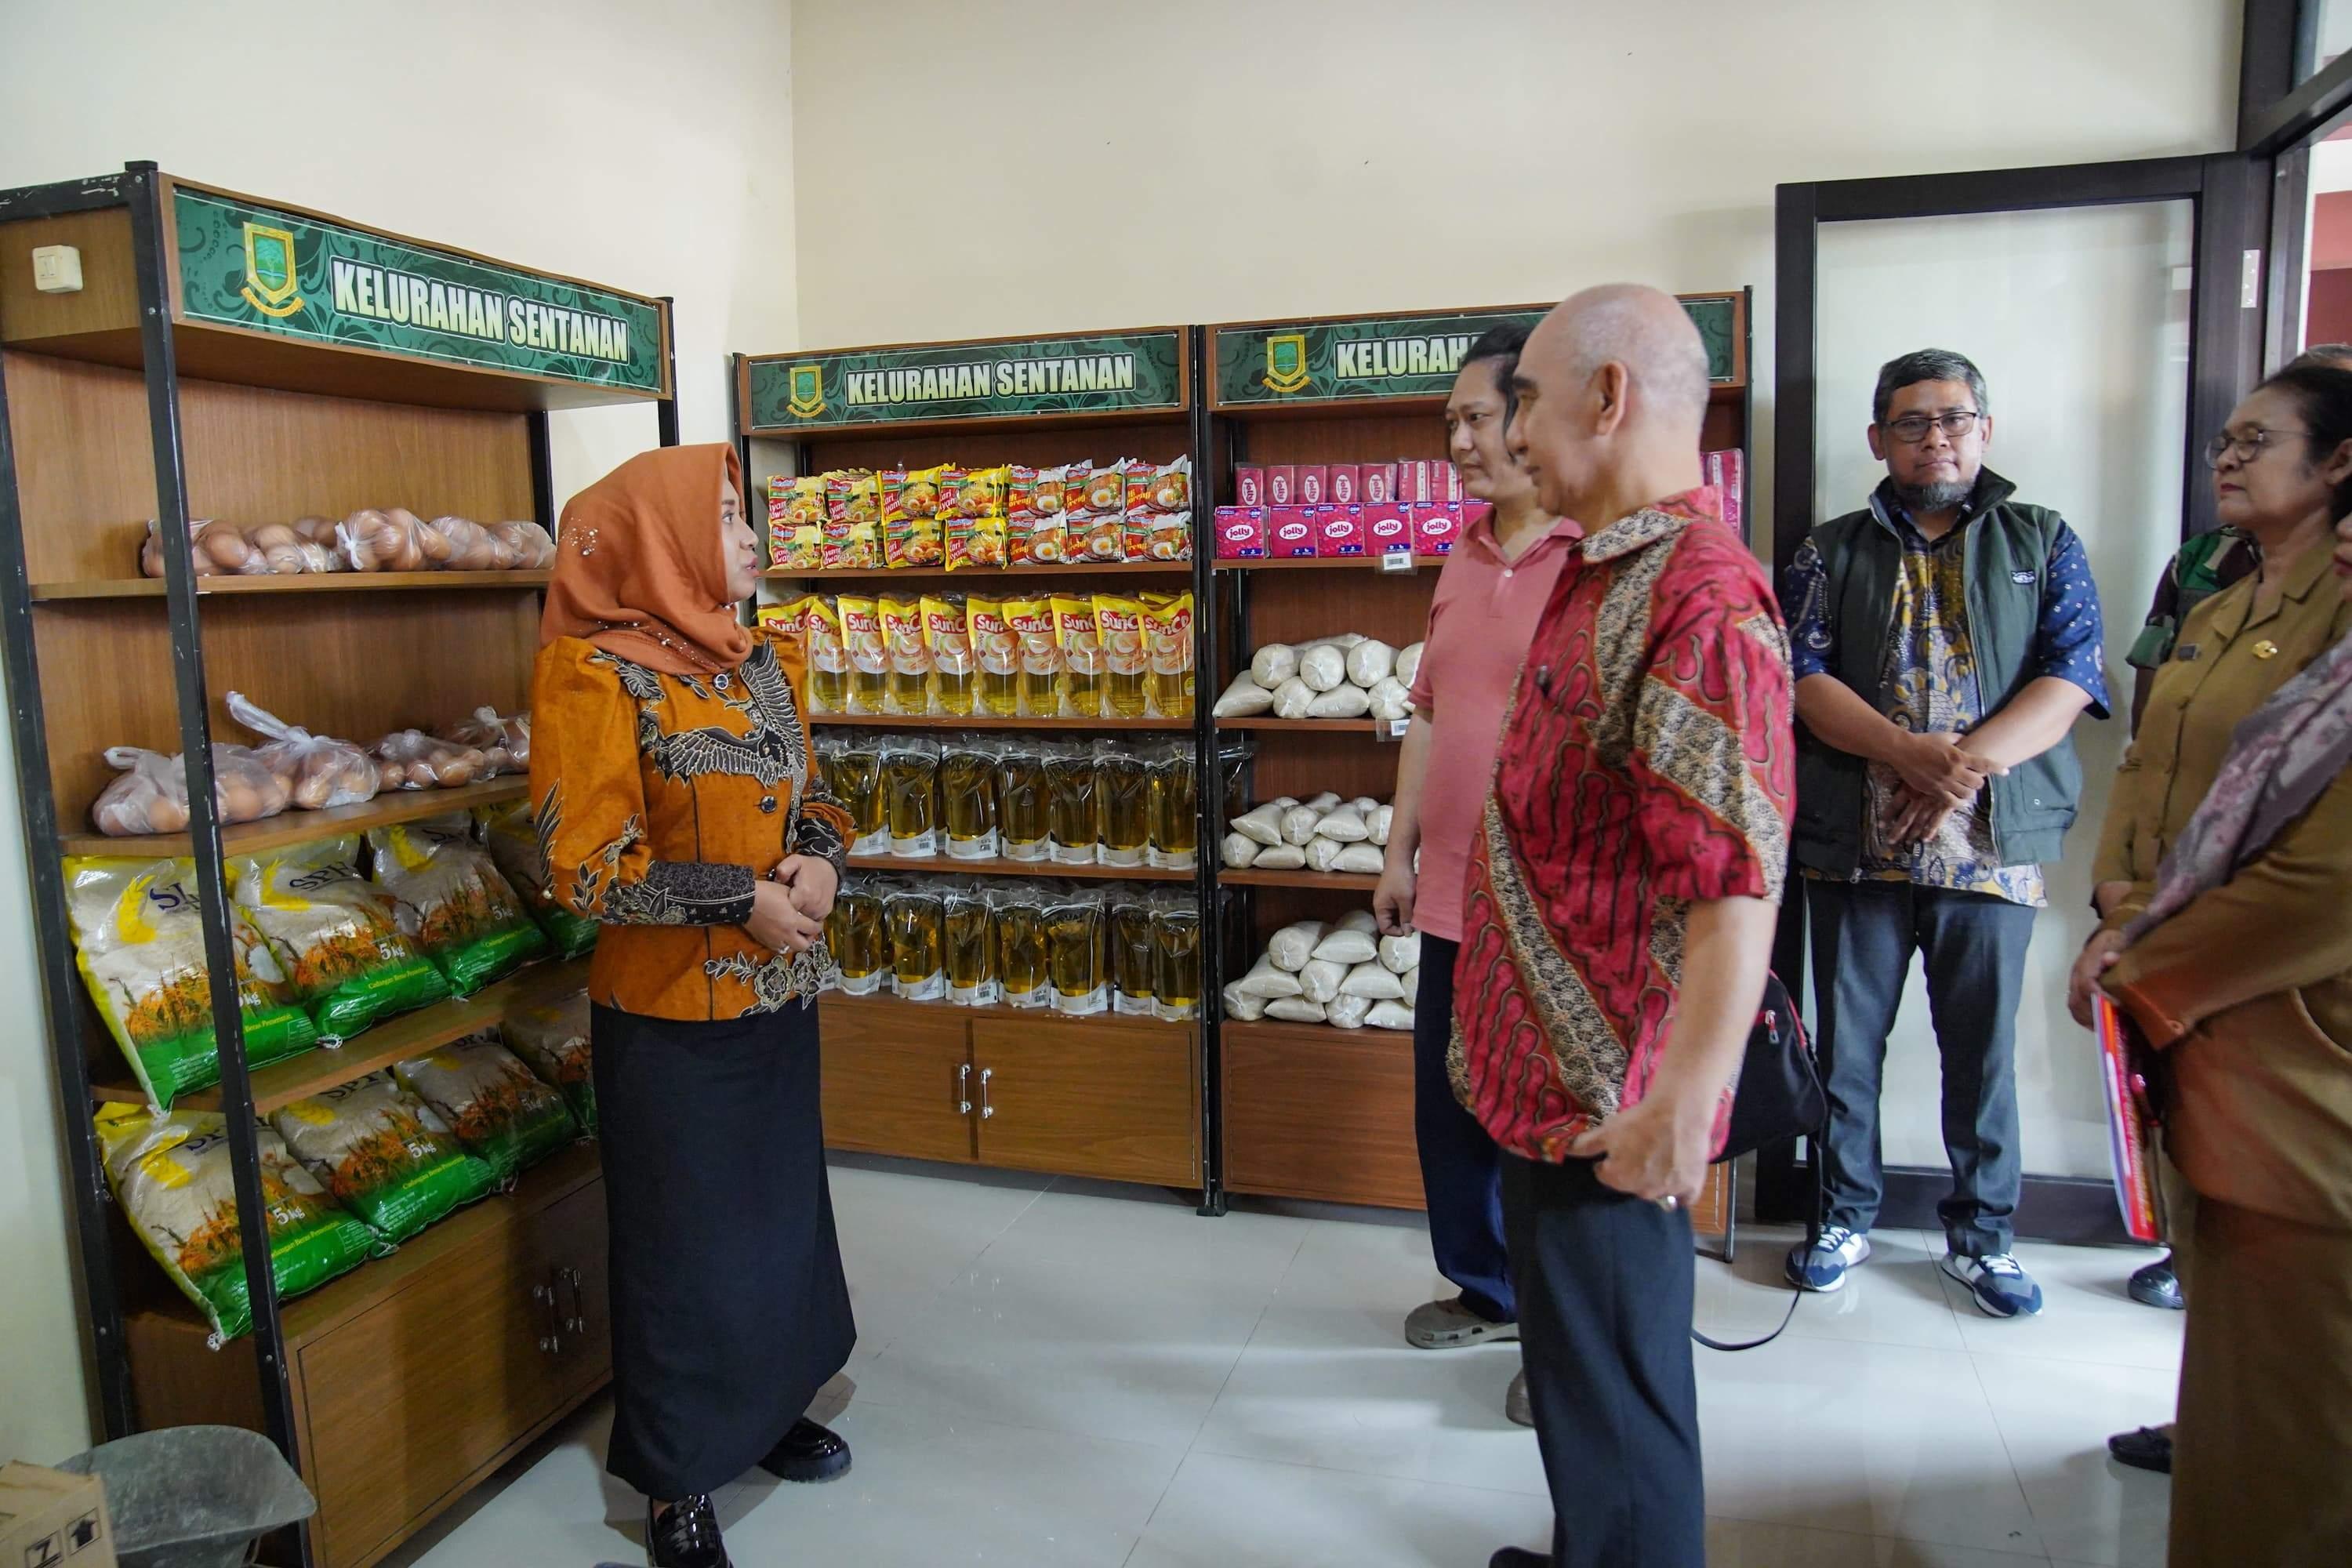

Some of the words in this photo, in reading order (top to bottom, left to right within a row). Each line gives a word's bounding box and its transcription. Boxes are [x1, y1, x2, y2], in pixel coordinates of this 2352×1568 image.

[332, 260, 504, 342] KELURAHAN
[509, 298, 628, 363] SENTANAN
[1337, 333, 1479, 379] KELURAH
[847, 363, 992, 405] KELURAHAN
[995, 355, 1133, 396] SENTANAN
[1244, 482, 1254, 501] jolly
[1229, 528, 1249, 539] jolly
[1283, 526, 1303, 538] jolly
[1330, 523, 1349, 535] jolly
[1377, 522, 1398, 533] jolly
[1427, 521, 1447, 532] jolly
[768, 614, 808, 632] SunC
[848, 614, 880, 632] SunC
[887, 614, 921, 633] SunC
[930, 615, 966, 633] SunC
[977, 615, 1004, 633] Sun
[1012, 612, 1053, 632] SunC
[1063, 615, 1094, 630] SunC
[1100, 612, 1138, 630] SunC
